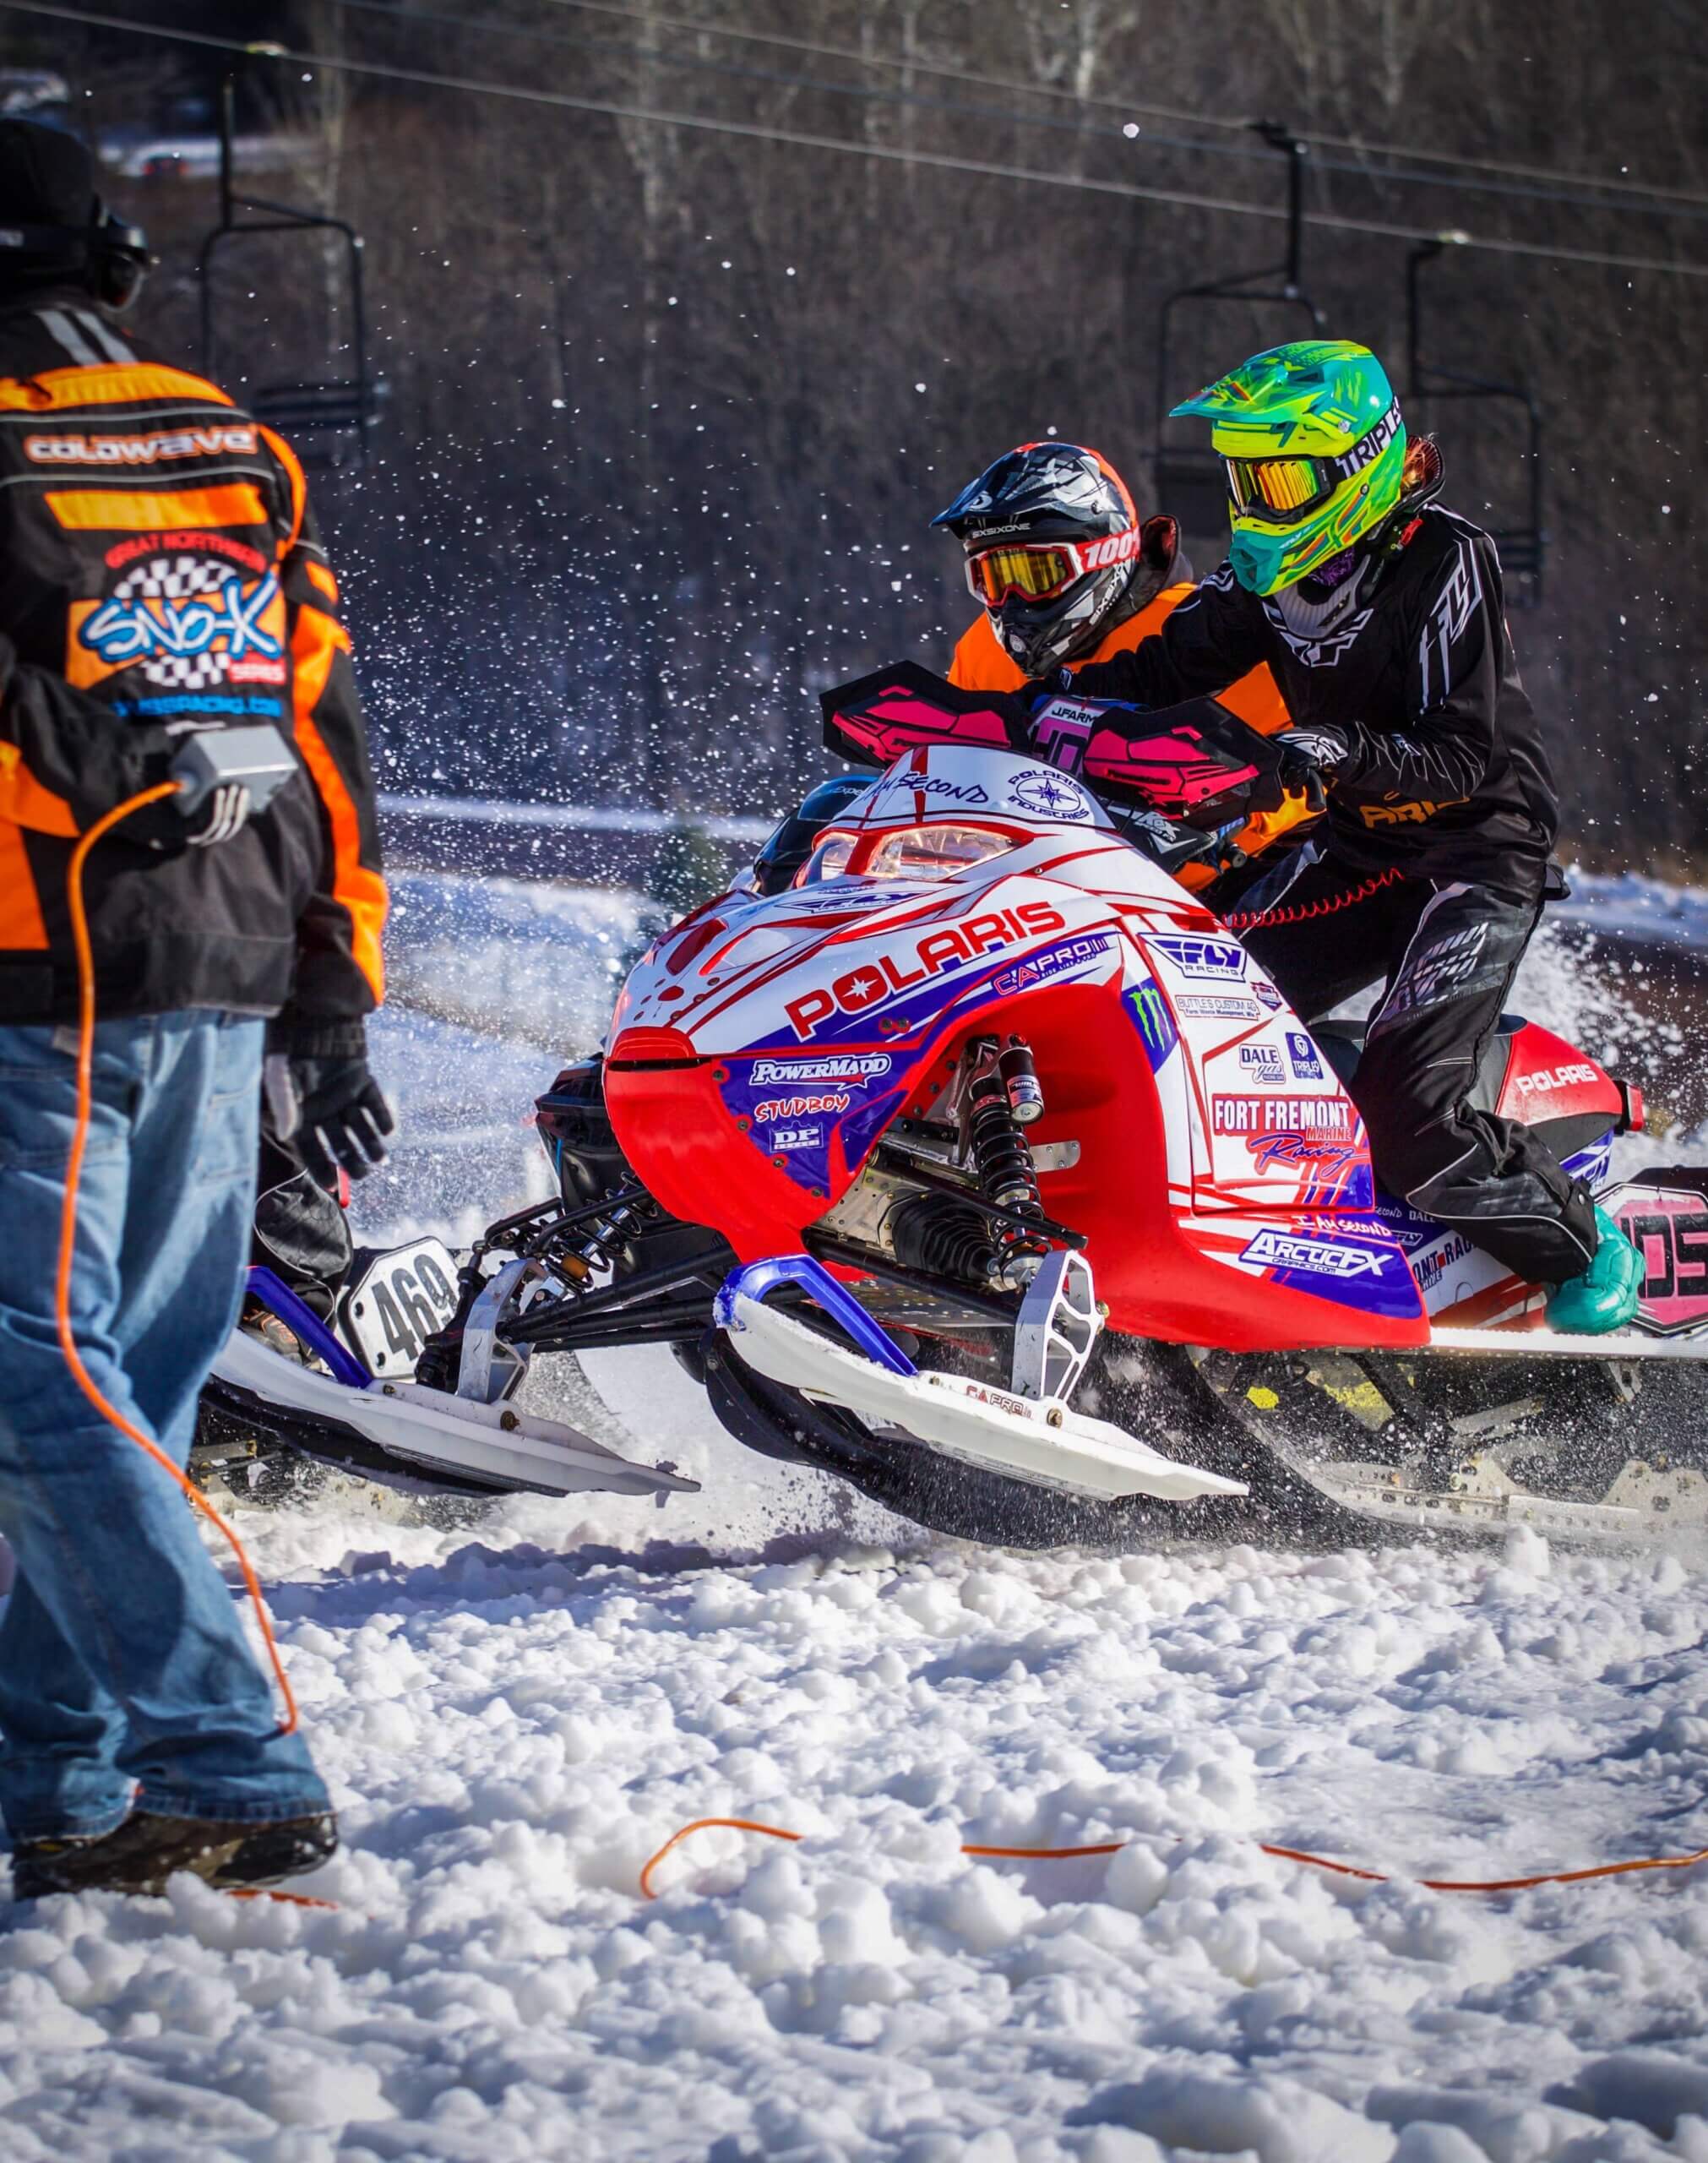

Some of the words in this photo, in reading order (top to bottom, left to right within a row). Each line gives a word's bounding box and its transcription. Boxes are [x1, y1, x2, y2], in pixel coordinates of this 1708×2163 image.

[893, 771, 989, 804] SECOND
[1008, 770, 1085, 794] POLARIS
[1007, 795, 1090, 820] INDUSTRIES
[1174, 940, 1242, 968] FLY
[784, 901, 1066, 1039] POLARIS
[1184, 964, 1239, 976] RACING
[1241, 1048, 1279, 1064] DALE
[1515, 1063, 1599, 1096] POLARIS
[754, 1093, 850, 1122] STUDBOY
[1215, 1100, 1260, 1131] FORT
[1265, 1100, 1350, 1131] FREMONT
[774, 1128, 819, 1144] DP
[1307, 1126, 1352, 1141] MARINE
[1249, 1133, 1369, 1178] Racing
[1375, 1205, 1403, 1218] ECOND
[1271, 1257, 1336, 1273] GRAPHICS.COM
